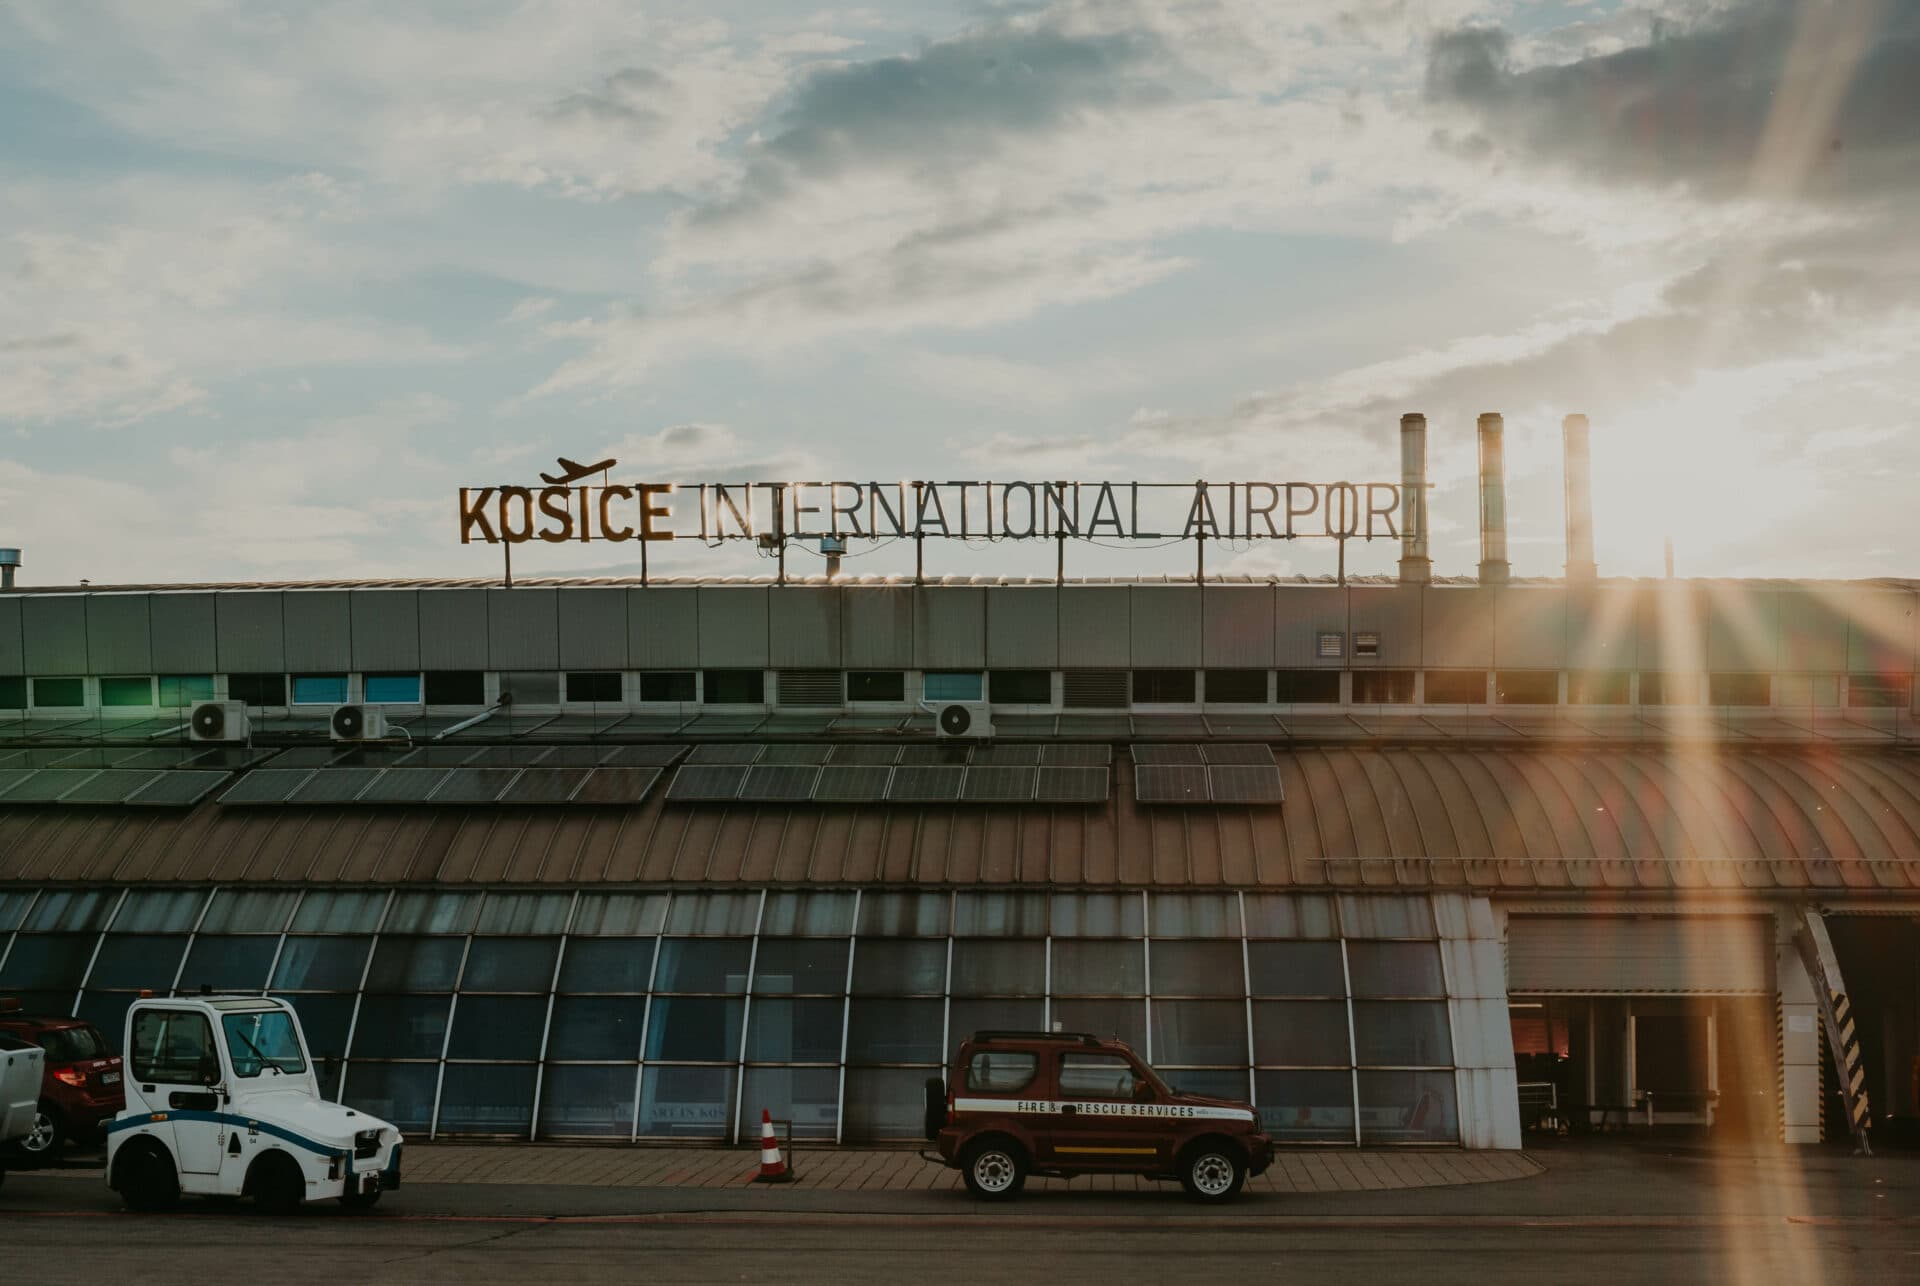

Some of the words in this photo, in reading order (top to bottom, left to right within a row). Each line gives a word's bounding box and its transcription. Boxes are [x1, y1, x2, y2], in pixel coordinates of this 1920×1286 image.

[699, 481, 1161, 540] INTERNATIONAL
[1182, 480, 1435, 540] AIRPORT
[1018, 1101, 1045, 1112] FIRE
[1077, 1103, 1126, 1115] RESCUE
[1131, 1105, 1194, 1117] SERVICES
